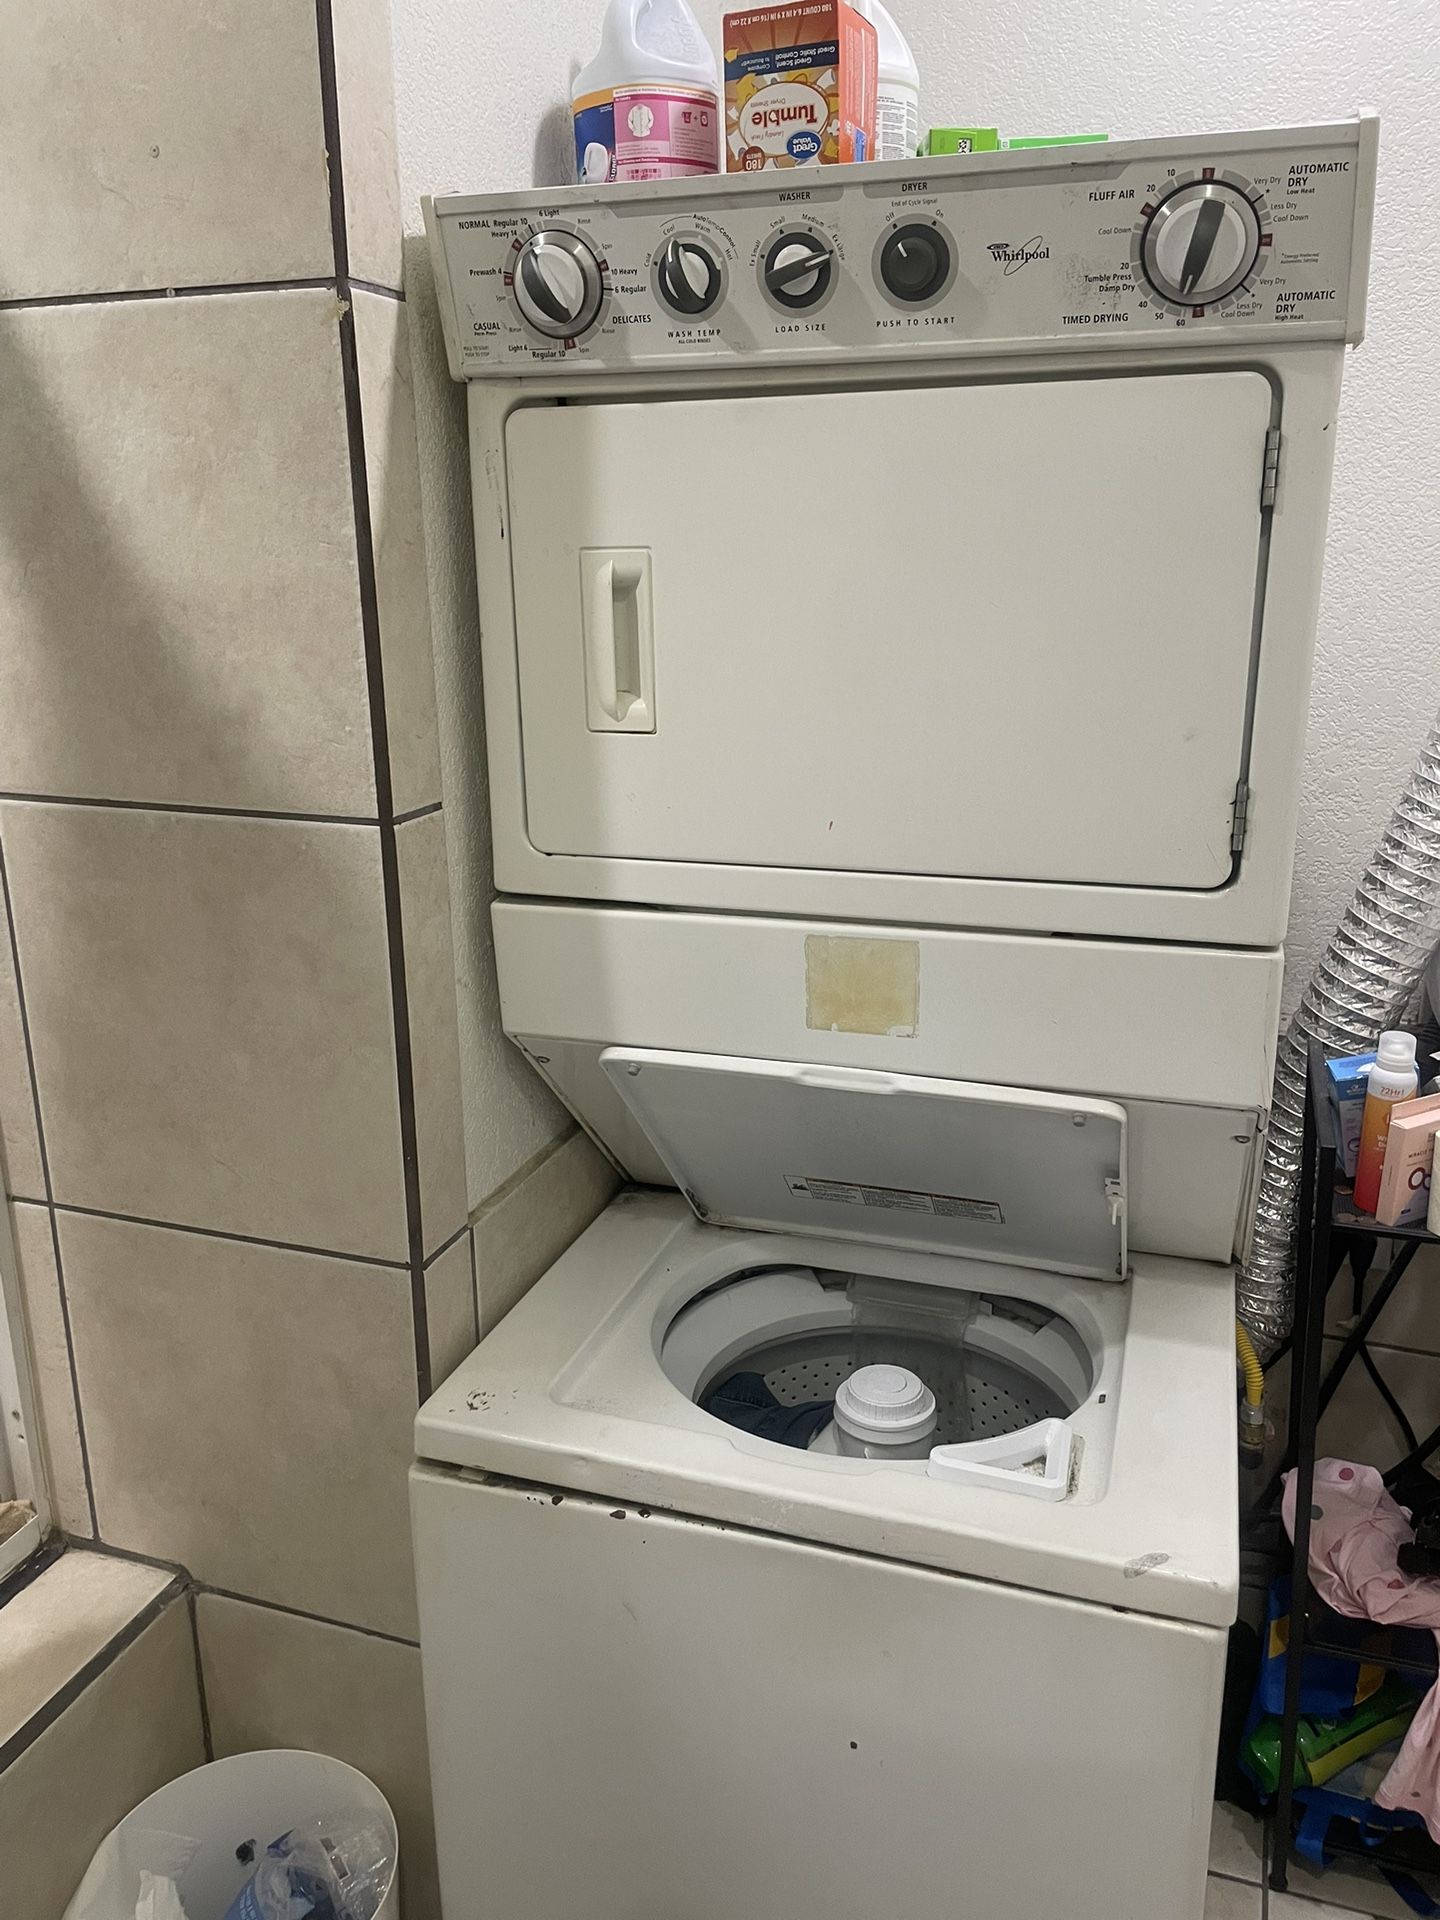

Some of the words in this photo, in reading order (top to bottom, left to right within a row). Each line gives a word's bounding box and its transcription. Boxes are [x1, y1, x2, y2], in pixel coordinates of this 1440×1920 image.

[803, 5, 821, 15] COUNT
[740, 17, 747, 26] 22
[800, 48, 817, 56] Static
[817, 46, 835, 55] Great
[794, 57, 812, 66] Great
[752, 104, 817, 128] Tumble
[792, 137, 812, 145] Value
[793, 143, 818, 153] Great
[745, 160, 762, 170] 180
[1288, 162, 1350, 175] AUTOMATIC
[1167, 169, 1176, 177] 10
[1254, 177, 1269, 185] Very
[1269, 176, 1281, 185] Dry
[1287, 177, 1309, 187] DRY
[902, 182, 928, 192] DRYER
[1146, 184, 1156, 193] 20
[779, 191, 811, 201] WASHER
[1088, 191, 1116, 201] FLUFF
[1118, 189, 1135, 200] AIR
[908, 199, 921, 207] Cycle
[1286, 202, 1297, 210] Dry
[544, 209, 560, 218] Light
[885, 212, 895, 222] Off
[935, 209, 945, 219] On
[1273, 214, 1289, 223] Cool
[458, 220, 491, 230] NORMAL
[493, 218, 518, 229] Regular
[520, 217, 528, 225] 10
[769, 216, 786, 229] Small
[802, 213, 825, 227] Medium
[662, 224, 675, 236] Cool
[695, 223, 711, 234] Warm
[1098, 228, 1113, 236] Cool
[1113, 227, 1133, 235] Down
[490, 230, 510, 239] Heavy
[601, 243, 613, 251] Spin
[751, 239, 761, 258] Small
[725, 248, 733, 261] Hot
[991, 247, 1050, 263] Whirlpool
[644, 253, 652, 268] Cold
[1120, 262, 1130, 270] 20
[469, 267, 497, 276] Prewash
[611, 268, 618, 276] 10
[619, 268, 638, 277] Heavy
[1084, 274, 1111, 283] Tumble
[1112, 273, 1132, 281] Press
[1259, 278, 1274, 286] Very
[1275, 277, 1286, 286] Dry
[614, 286, 620, 294] 6
[620, 284, 647, 295] Regular
[1098, 284, 1121, 293] Damp
[1122, 284, 1136, 293] Dry
[1276, 290, 1336, 302] AUTOMATIC
[1138, 300, 1148, 308] 40
[1236, 302, 1250, 310] Less
[1251, 302, 1263, 310] Dry
[1275, 303, 1296, 314] DRY
[612, 314, 652, 325] DELICATES
[1062, 315, 1091, 325] TIMED
[1093, 313, 1129, 323] DRYING
[1154, 312, 1164, 320] 50
[473, 322, 501, 331] CASUAL
[876, 320, 901, 328] PUSH
[907, 319, 919, 327] TO
[925, 316, 955, 326] START
[1176, 319, 1186, 327] 60
[667, 330, 692, 338] WASH
[697, 328, 721, 337] TEMP
[775, 325, 800, 333] LOAD
[805, 323, 826, 332] SIZE
[508, 344, 523, 353] Light
[531, 350, 557, 360] Regular
[558, 350, 566, 358] 10
